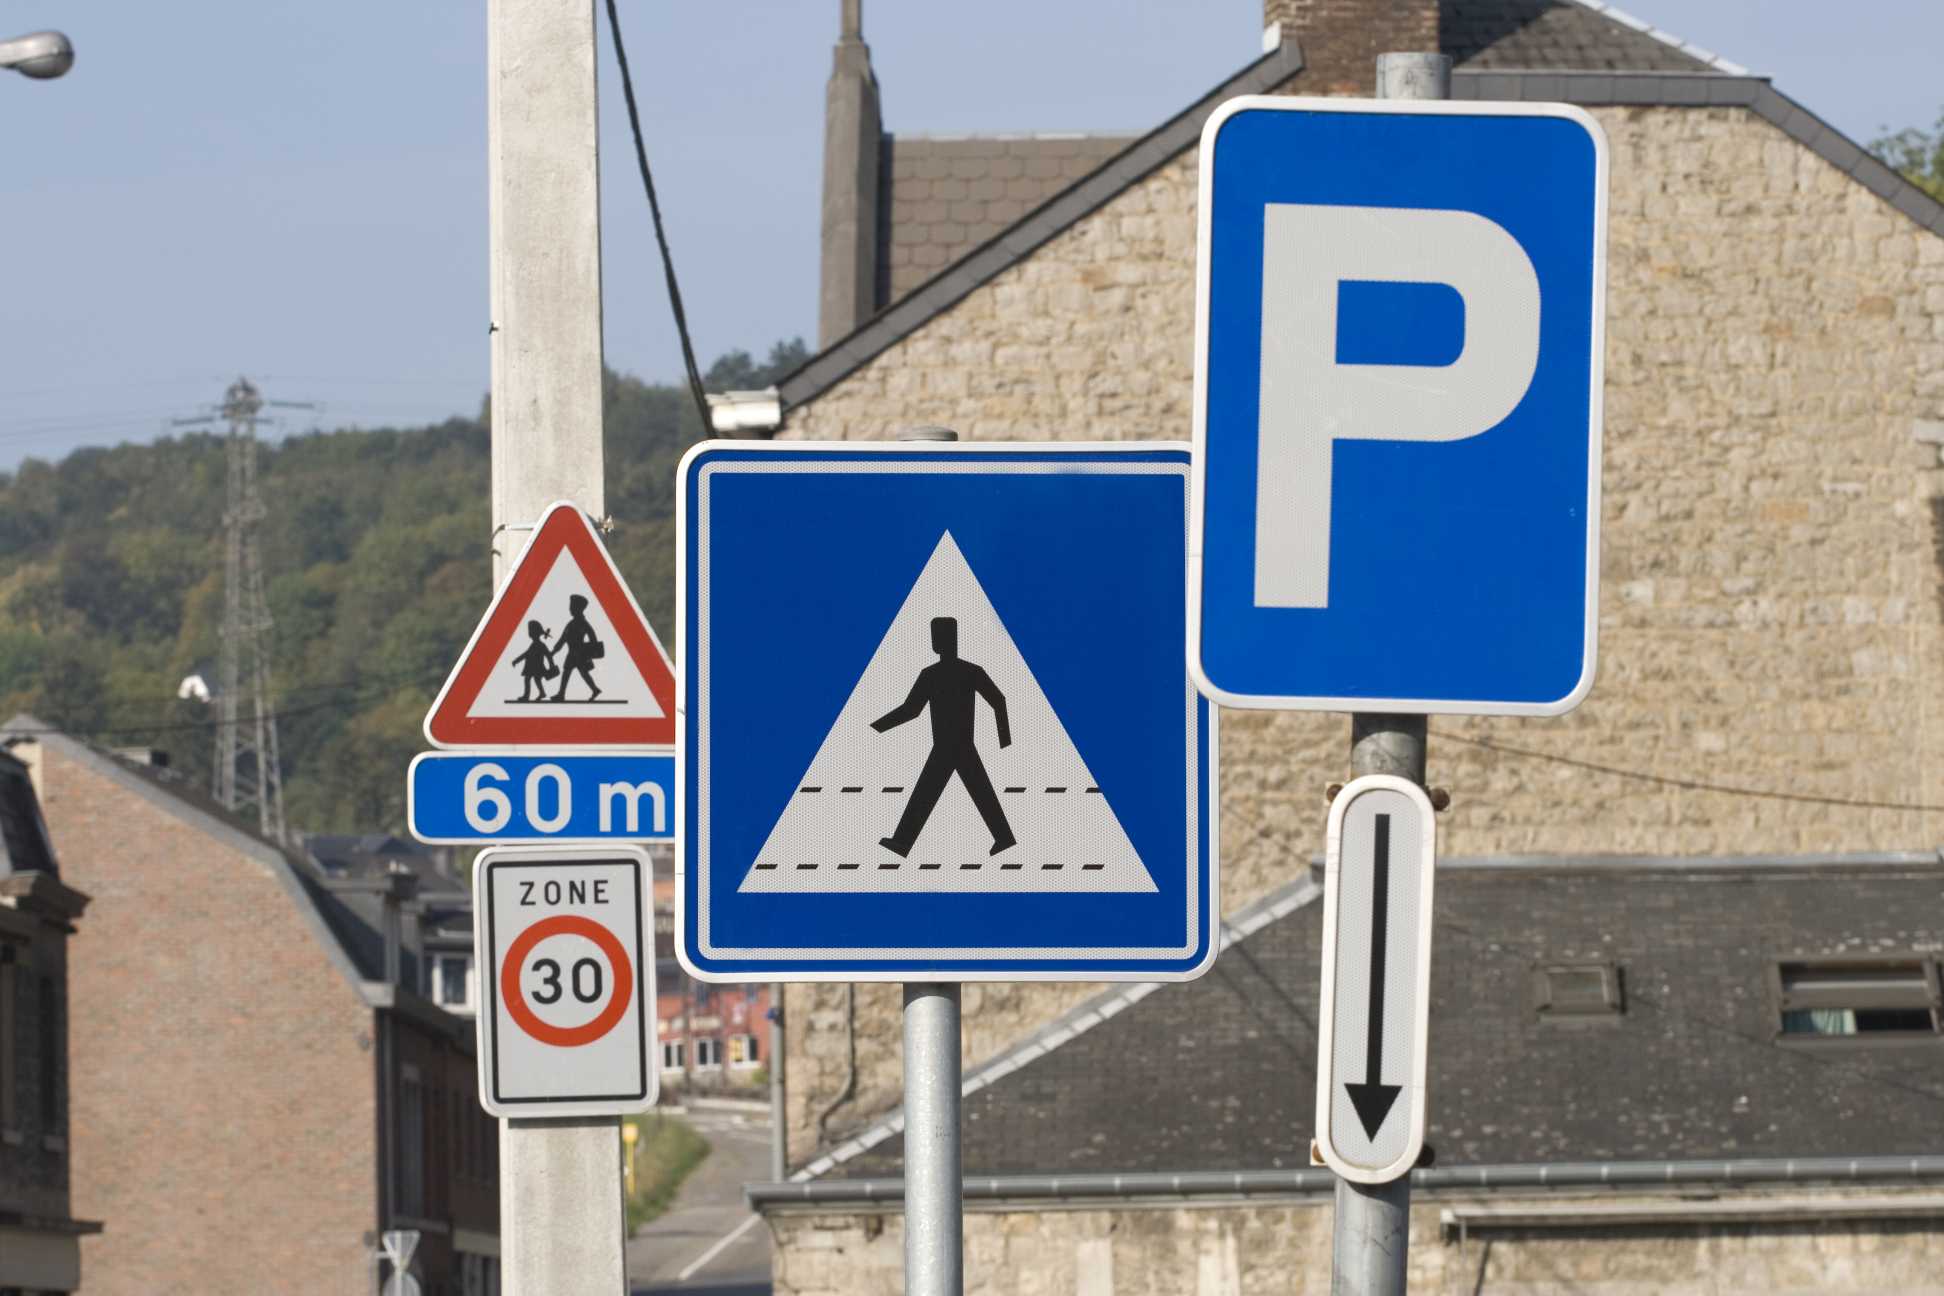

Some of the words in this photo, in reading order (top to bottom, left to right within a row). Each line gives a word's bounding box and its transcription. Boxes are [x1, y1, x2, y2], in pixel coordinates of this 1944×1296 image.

[1254, 203, 1541, 608] P
[464, 763, 571, 834] 60
[599, 781, 666, 832] m
[519, 880, 609, 906] ZONE
[532, 958, 603, 1004] 30
